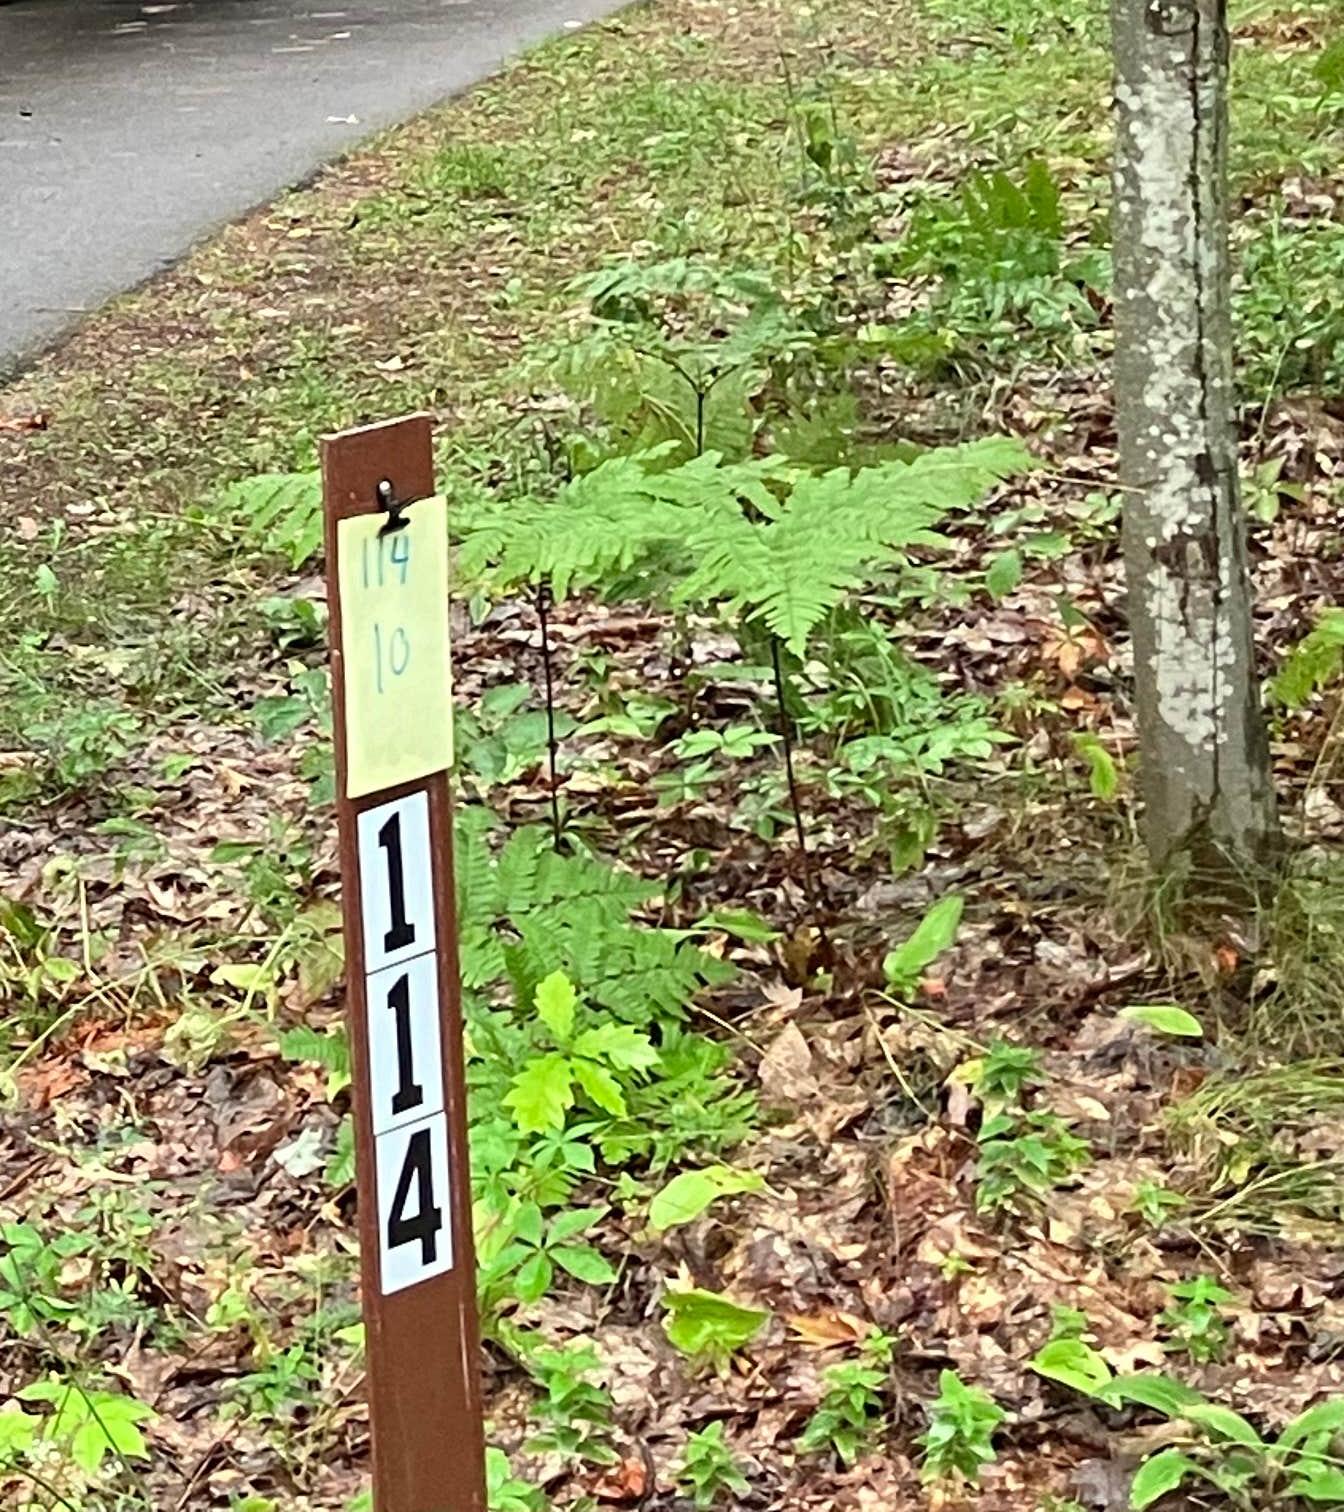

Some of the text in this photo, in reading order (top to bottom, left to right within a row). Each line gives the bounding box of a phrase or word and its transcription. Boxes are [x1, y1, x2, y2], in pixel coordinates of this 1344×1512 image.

[363, 533, 410, 589] 114
[374, 623, 411, 694] 10
[378, 811, 443, 1266] 114
